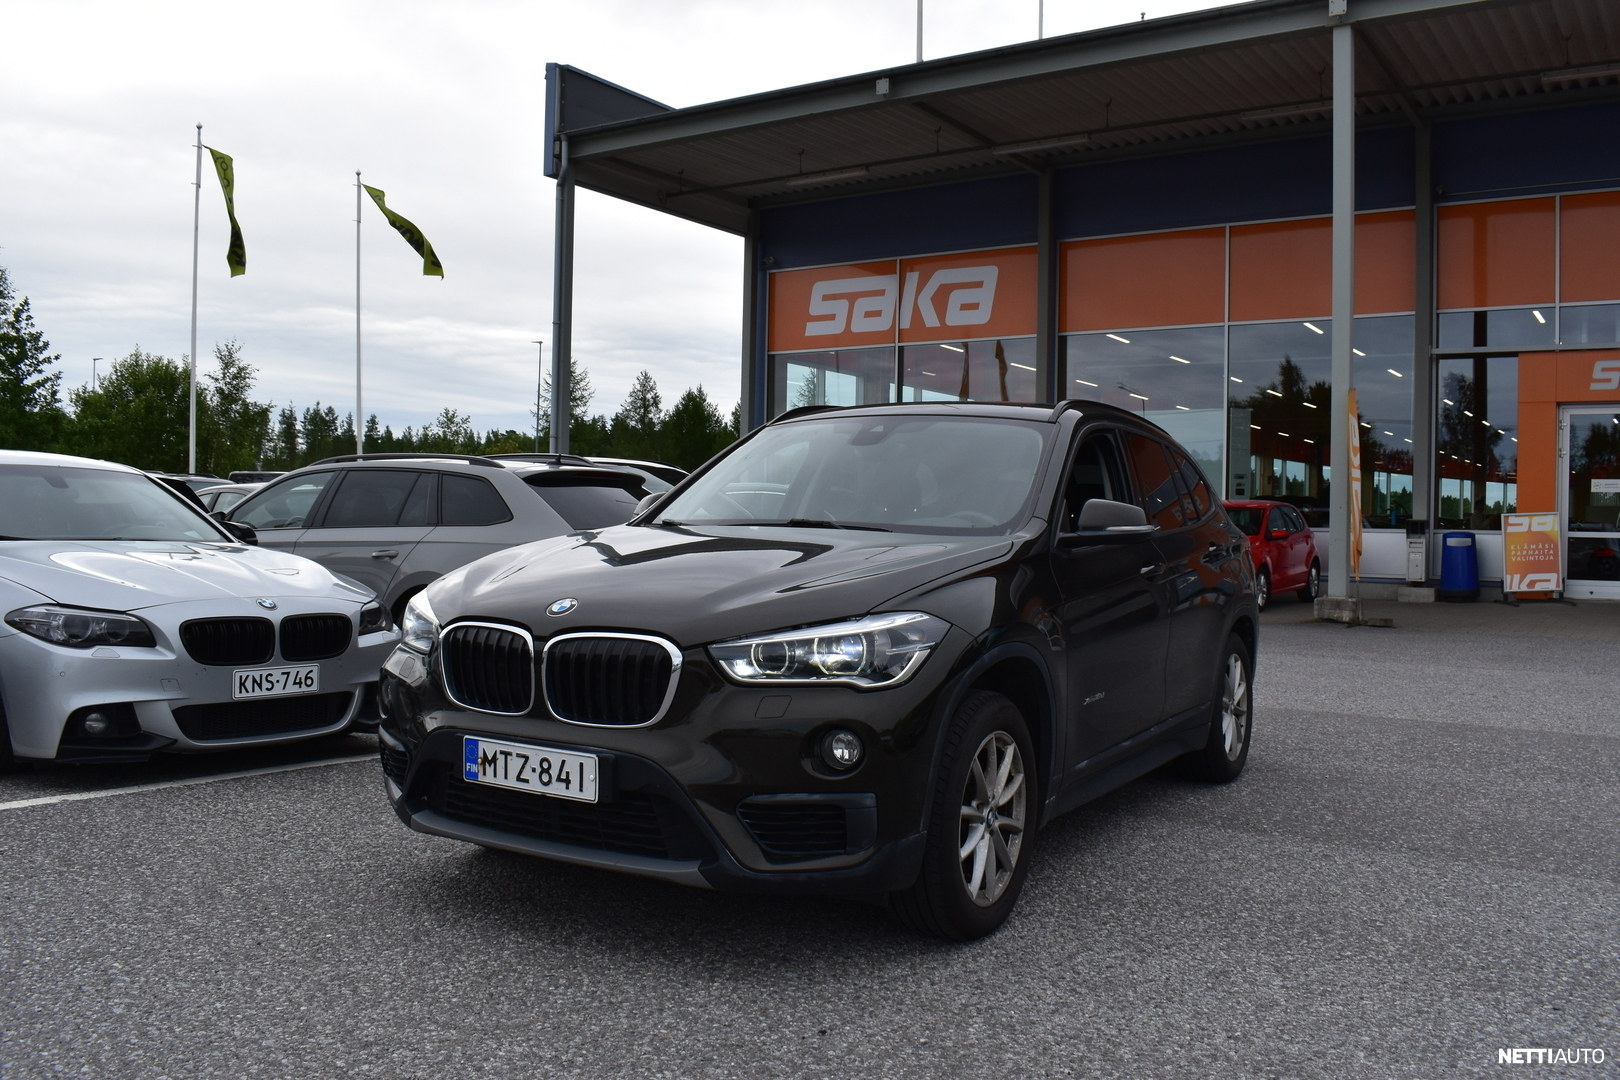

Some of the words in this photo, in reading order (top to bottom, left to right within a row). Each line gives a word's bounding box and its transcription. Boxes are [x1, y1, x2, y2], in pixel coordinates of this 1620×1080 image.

[239, 669, 314, 694] KNS-746
[466, 762, 478, 773] FIN
[482, 747, 583, 792] MTZ-841
